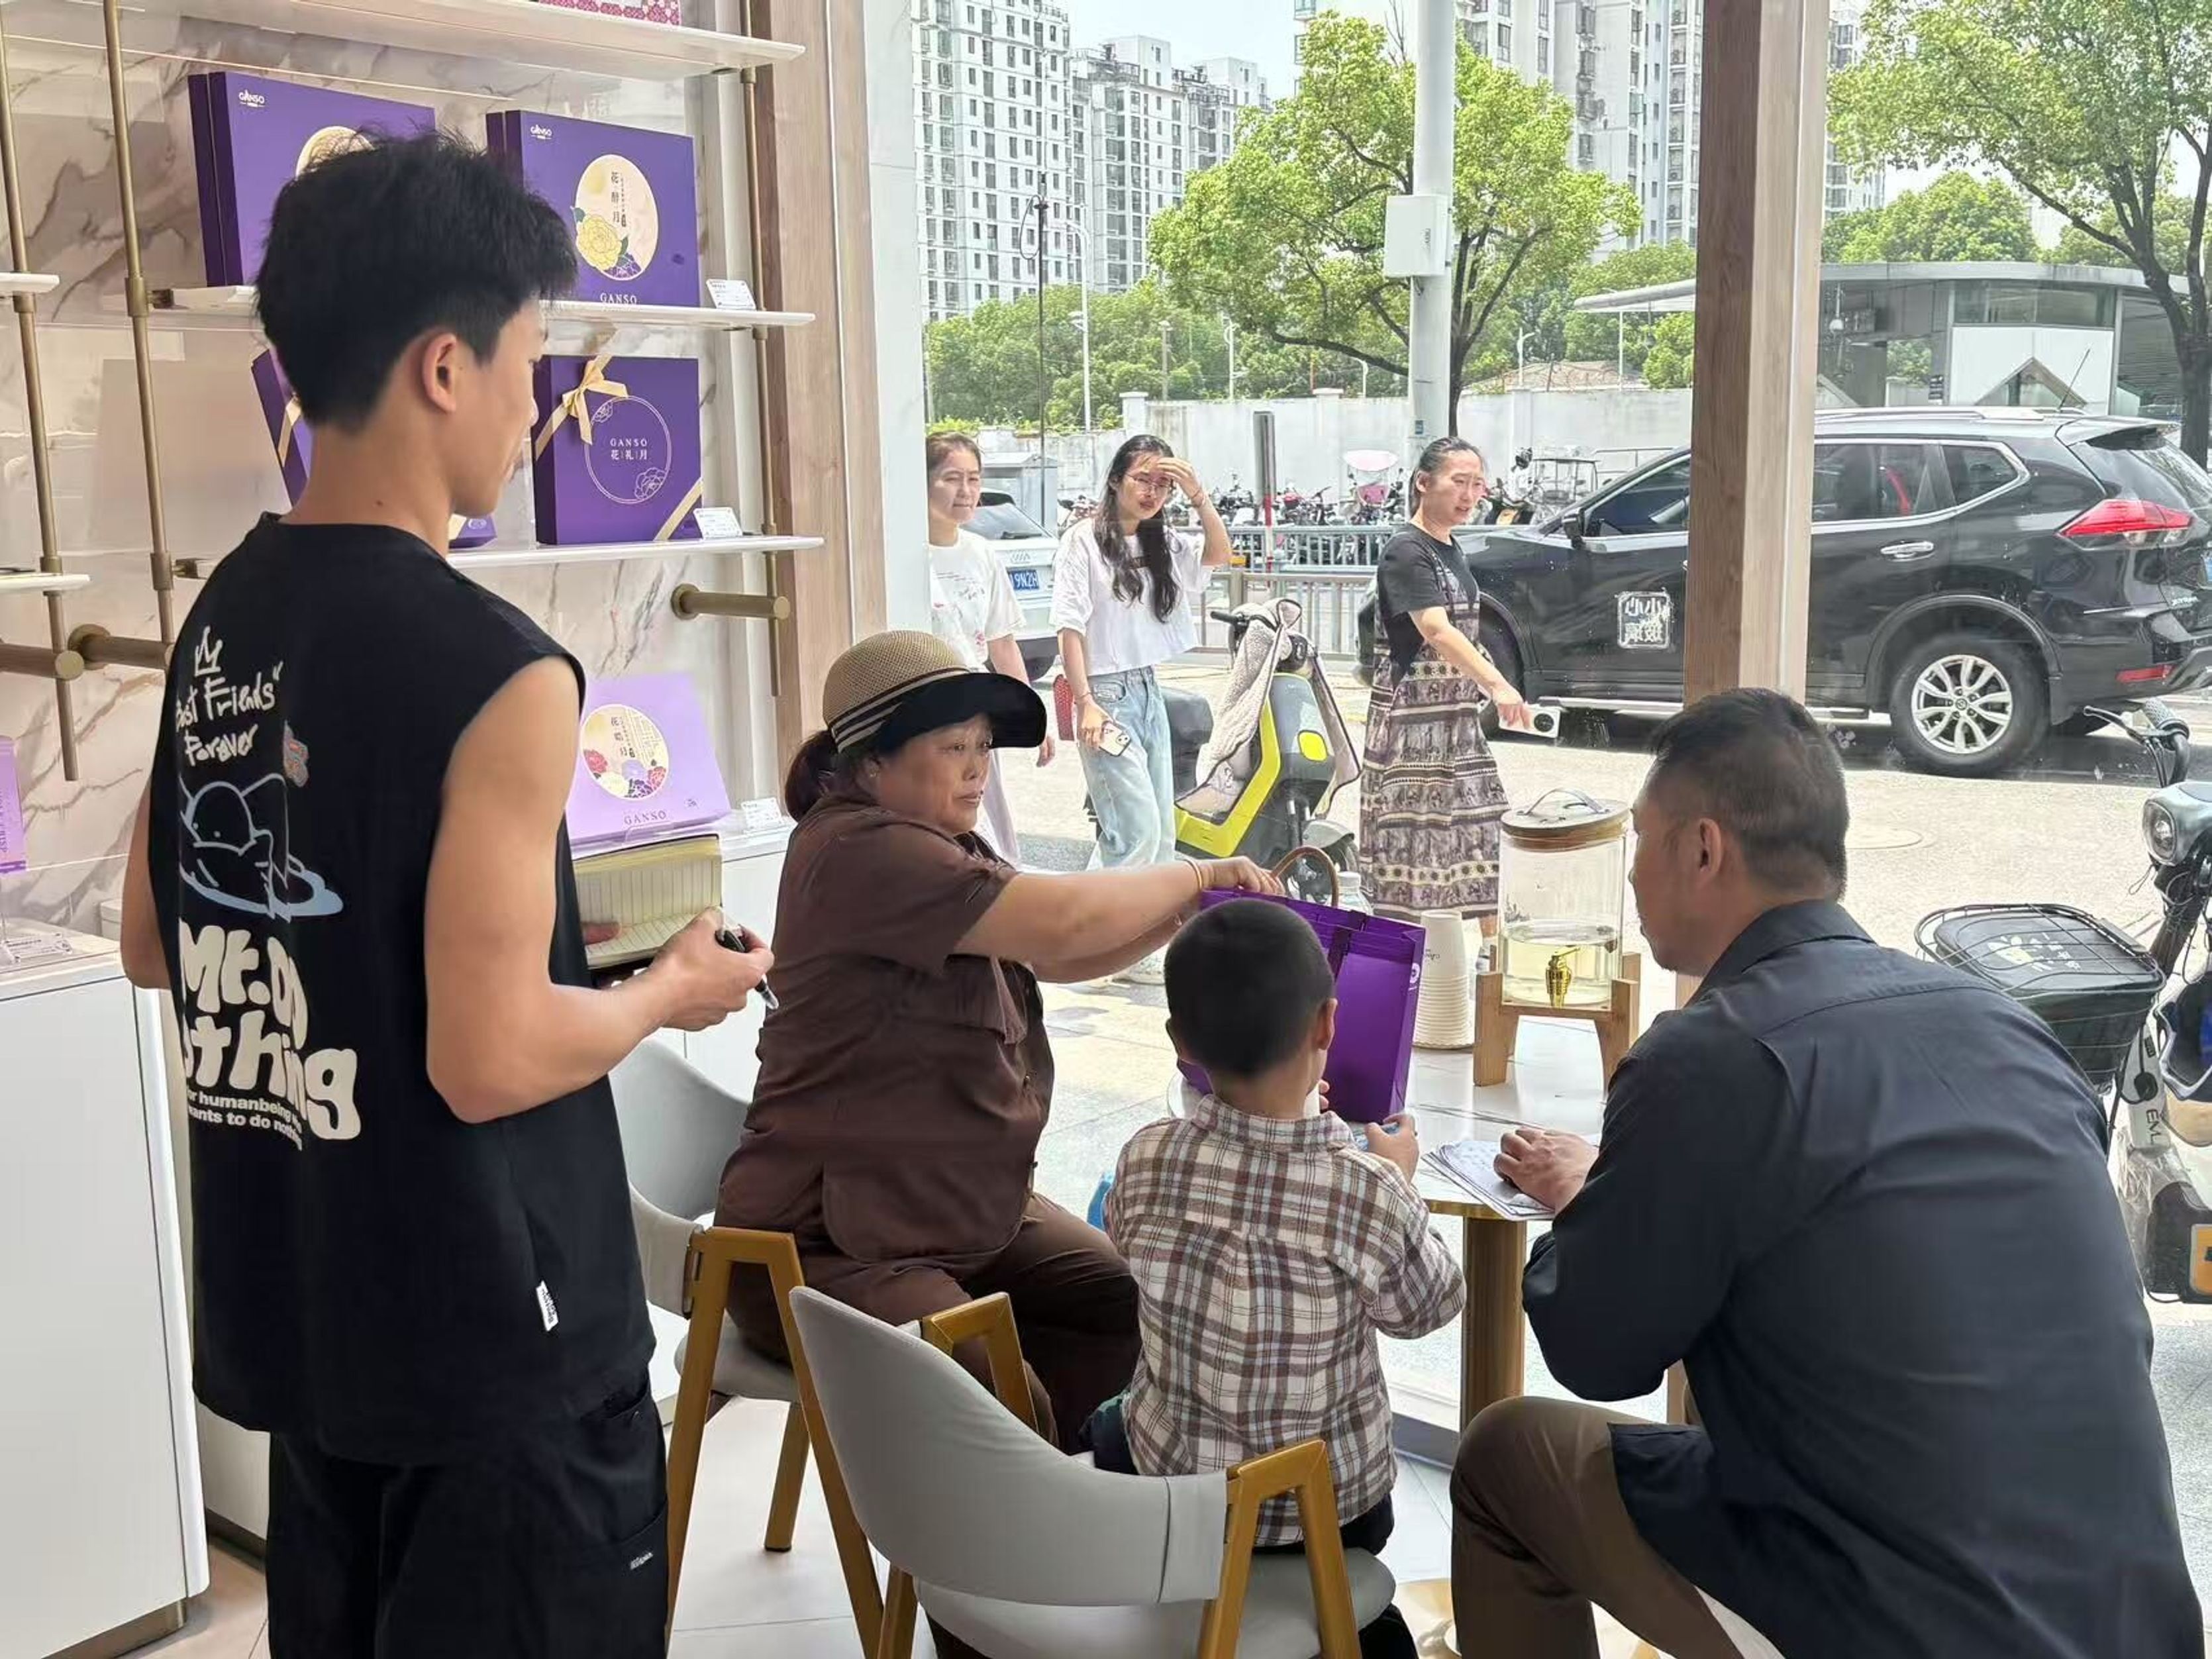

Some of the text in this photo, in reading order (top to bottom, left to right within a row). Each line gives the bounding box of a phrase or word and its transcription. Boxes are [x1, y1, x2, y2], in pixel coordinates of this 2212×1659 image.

[599, 293, 637, 305] GANSO
[609, 438, 648, 448] GANSO
[624, 810, 666, 825] GANSO
[226, 1112, 246, 1126] to
[249, 1114, 271, 1129] do
